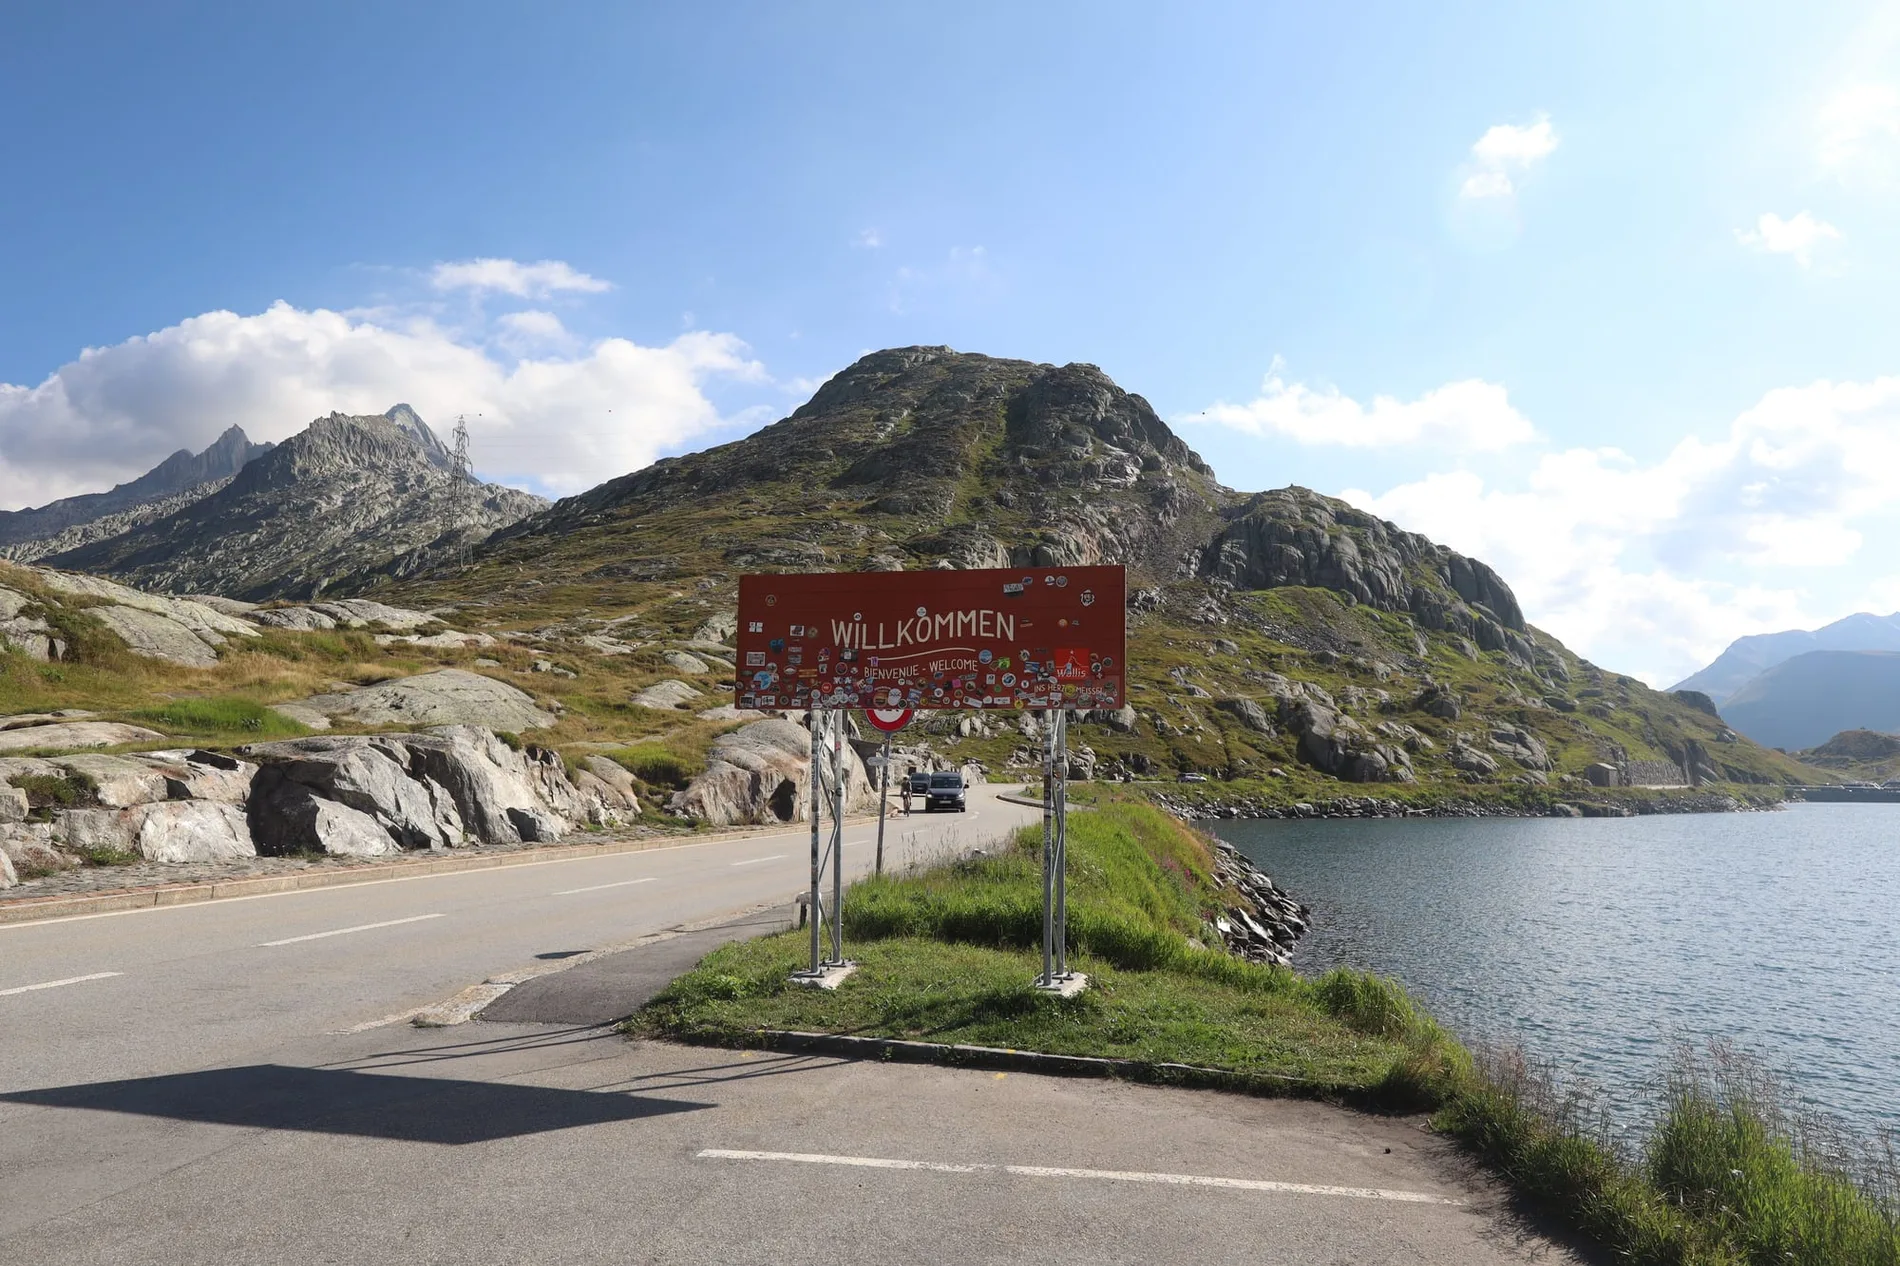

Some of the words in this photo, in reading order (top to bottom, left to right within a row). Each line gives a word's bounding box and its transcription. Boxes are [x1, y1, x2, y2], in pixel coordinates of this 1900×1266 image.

[831, 609, 1014, 650] WILLKOMMEN
[864, 664, 920, 680] BIENVENUE
[929, 658, 979, 673] WELCOME
